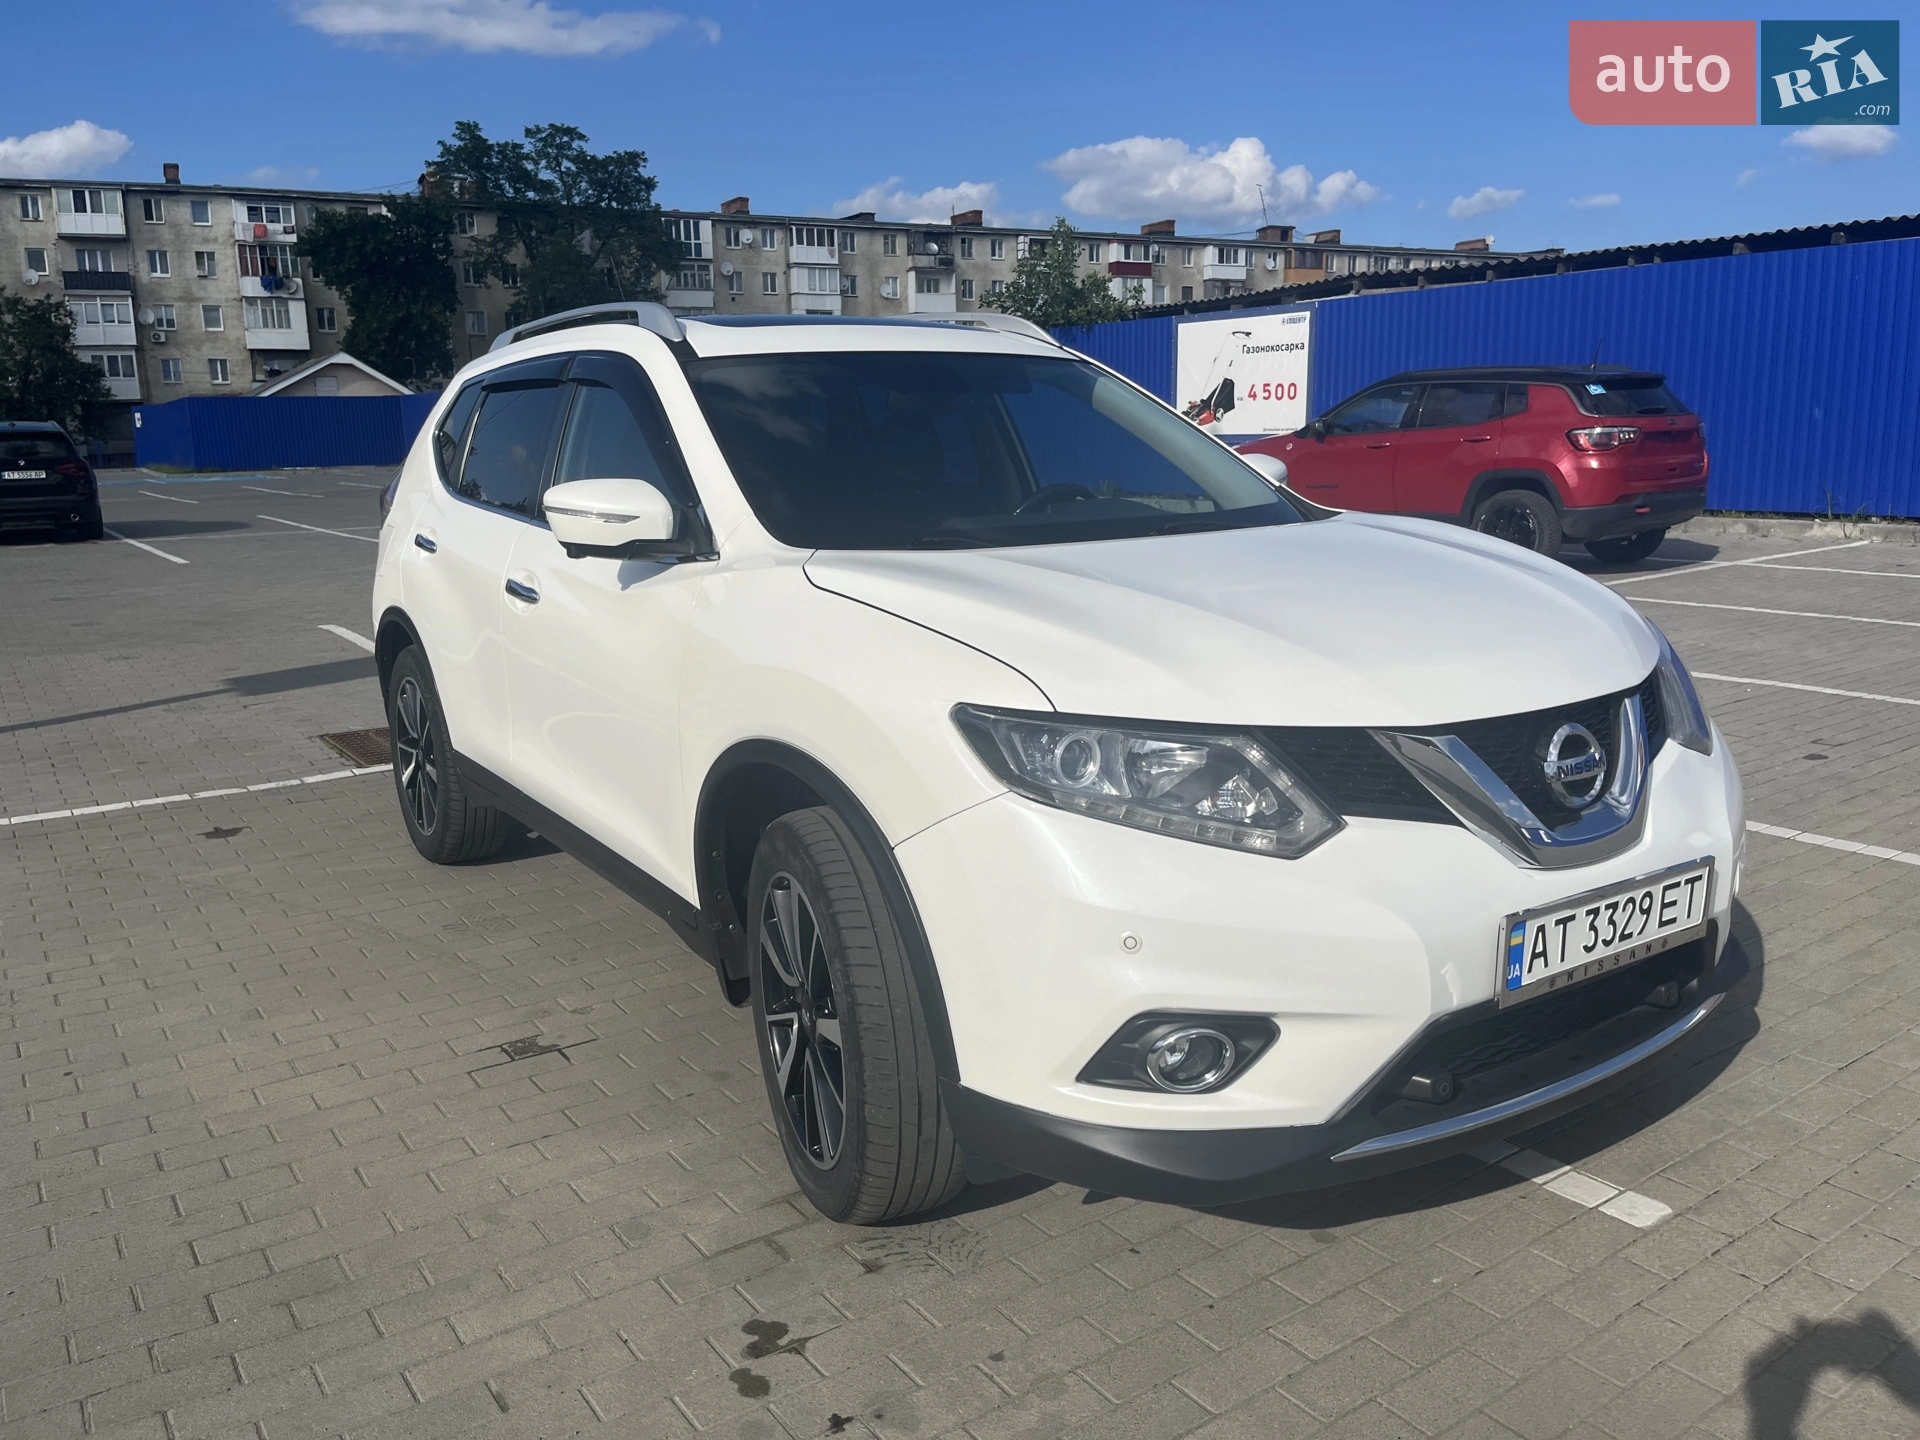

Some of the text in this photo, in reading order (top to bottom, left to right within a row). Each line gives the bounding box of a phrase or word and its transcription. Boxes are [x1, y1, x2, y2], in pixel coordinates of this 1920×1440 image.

[1241, 341, 1305, 355] Газонокосарка
[1247, 382, 1298, 401] 4500
[1556, 756, 1606, 778] NISSAN
[1526, 873, 1704, 975] AT 3329 ET
[1507, 964, 1521, 980] UA
[1566, 943, 1652, 983] NISSAN
